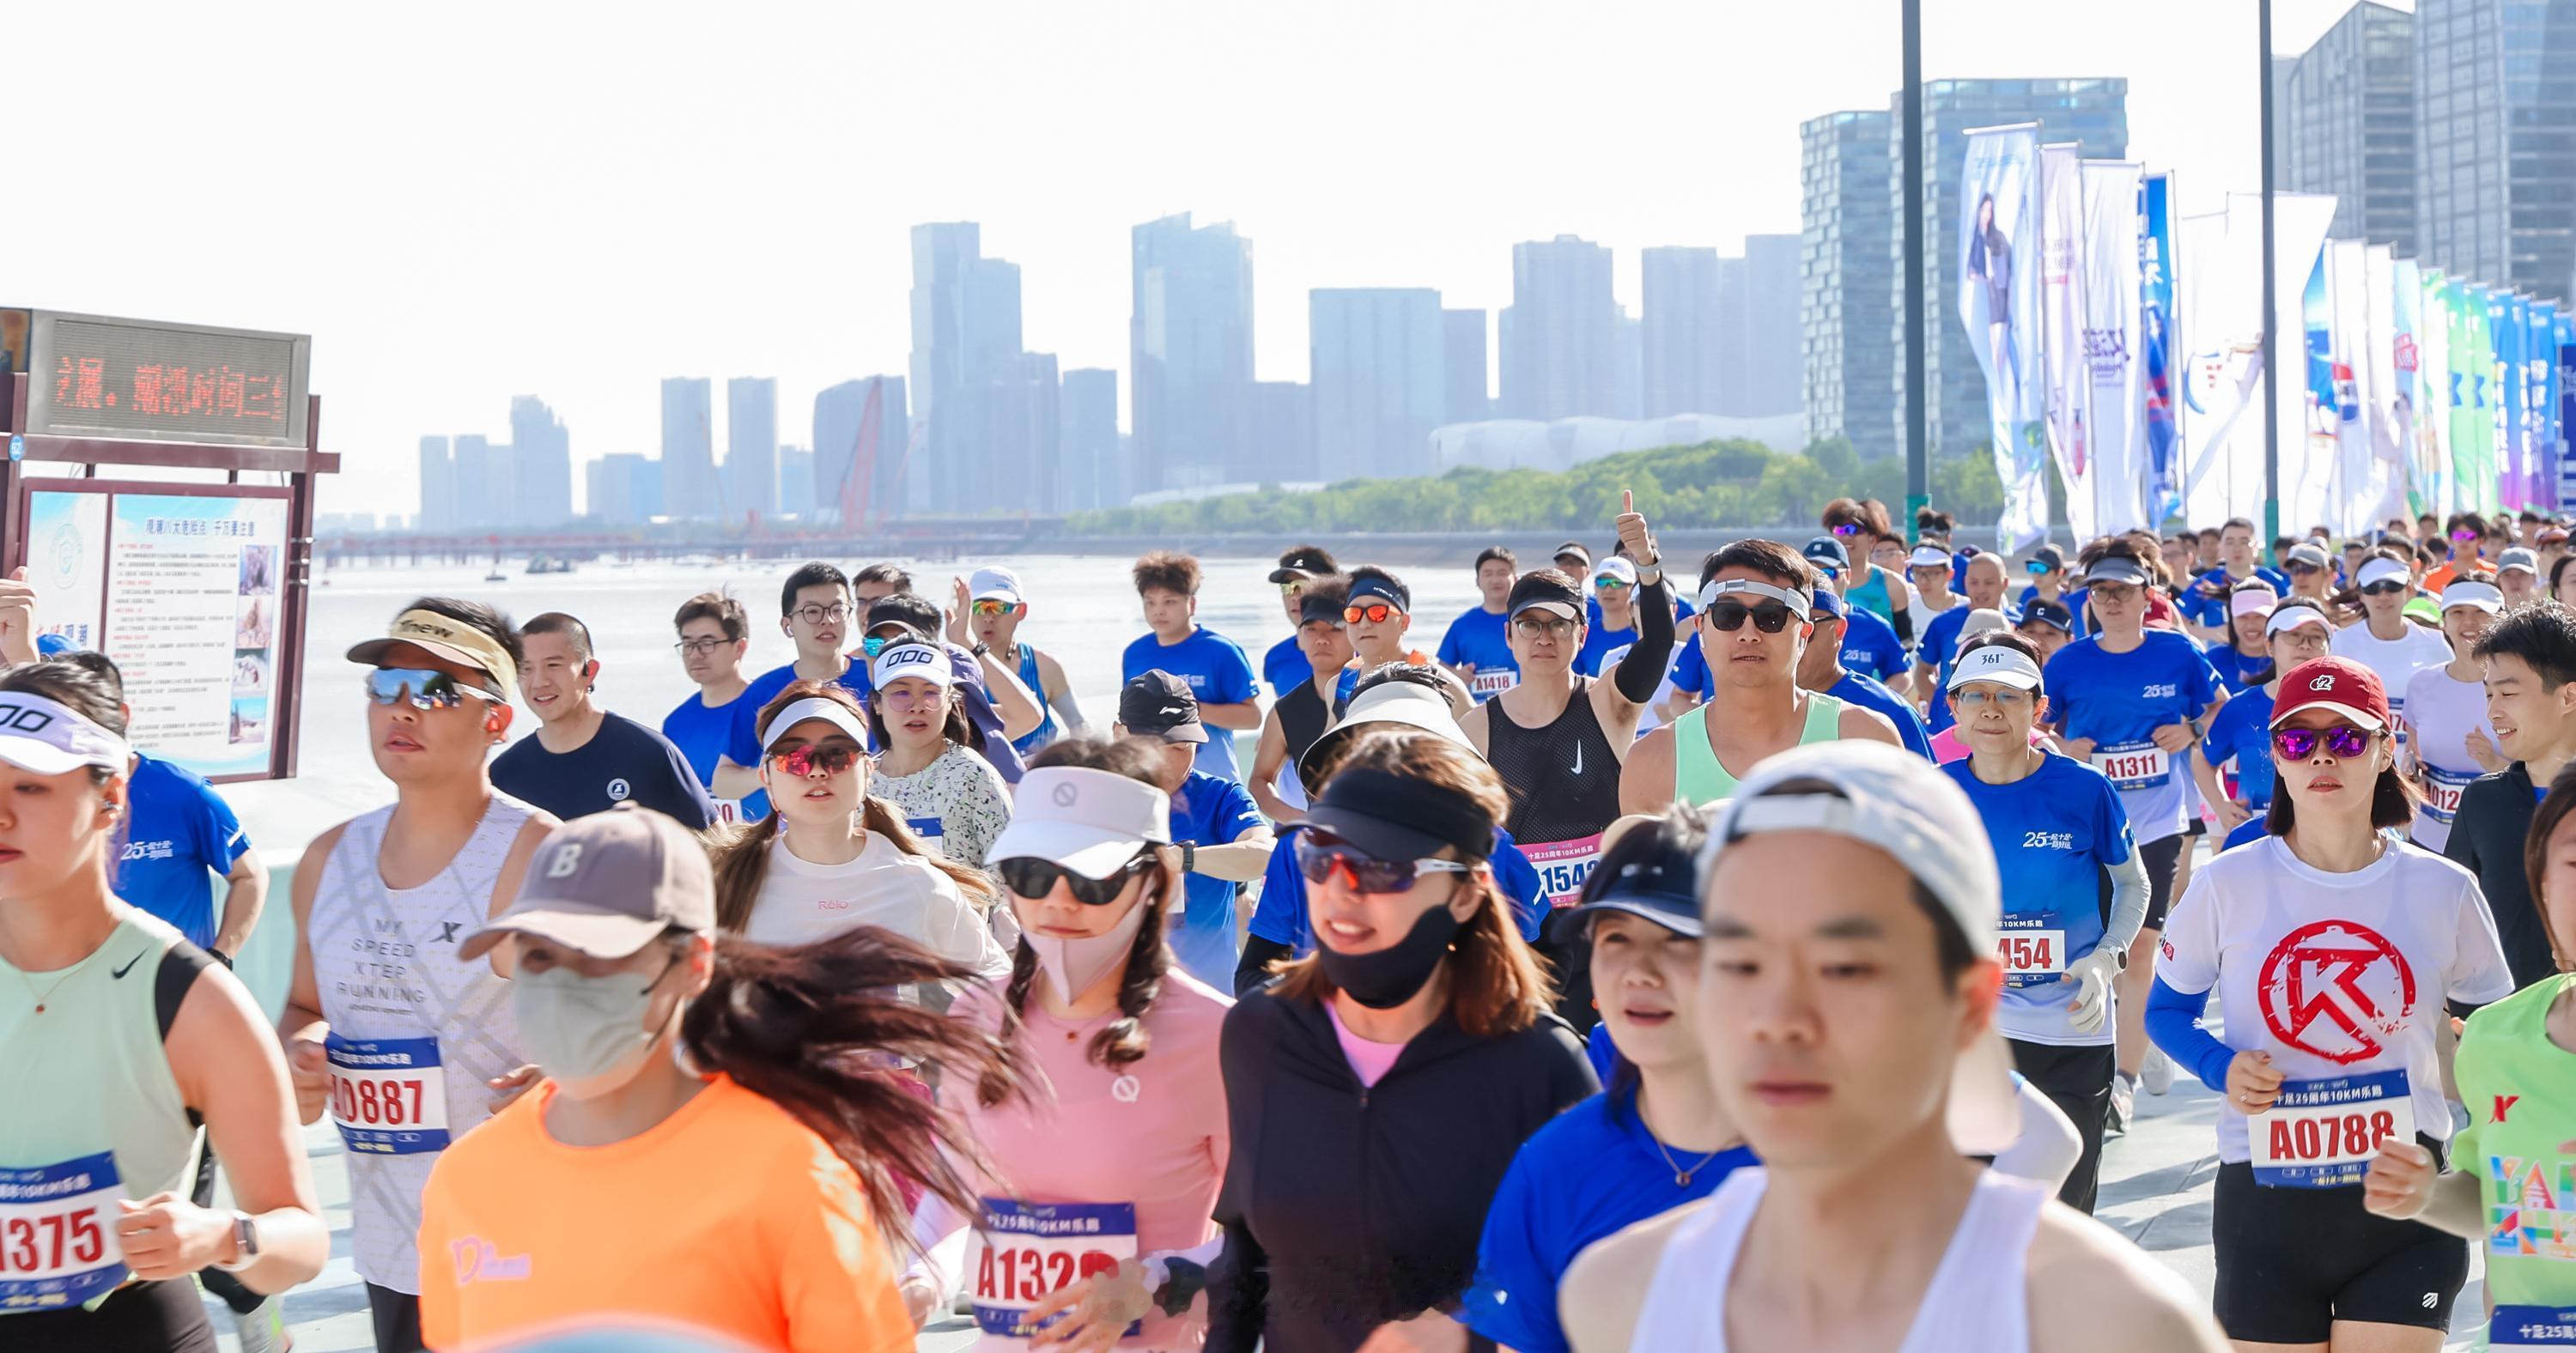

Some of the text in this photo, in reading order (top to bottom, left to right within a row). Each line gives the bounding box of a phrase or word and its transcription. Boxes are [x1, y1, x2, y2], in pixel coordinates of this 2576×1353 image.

[1476, 675, 1510, 691] A1418
[2105, 754, 2158, 779] A1311
[2022, 831, 2047, 847] 25
[120, 841, 145, 860] 25
[546, 844, 582, 877] B
[375, 919, 403, 932] MY
[352, 938, 415, 957] SPEED
[354, 961, 406, 979] XTEP
[337, 981, 426, 1003] RUNNING
[2269, 1110, 2396, 1162] A0788
